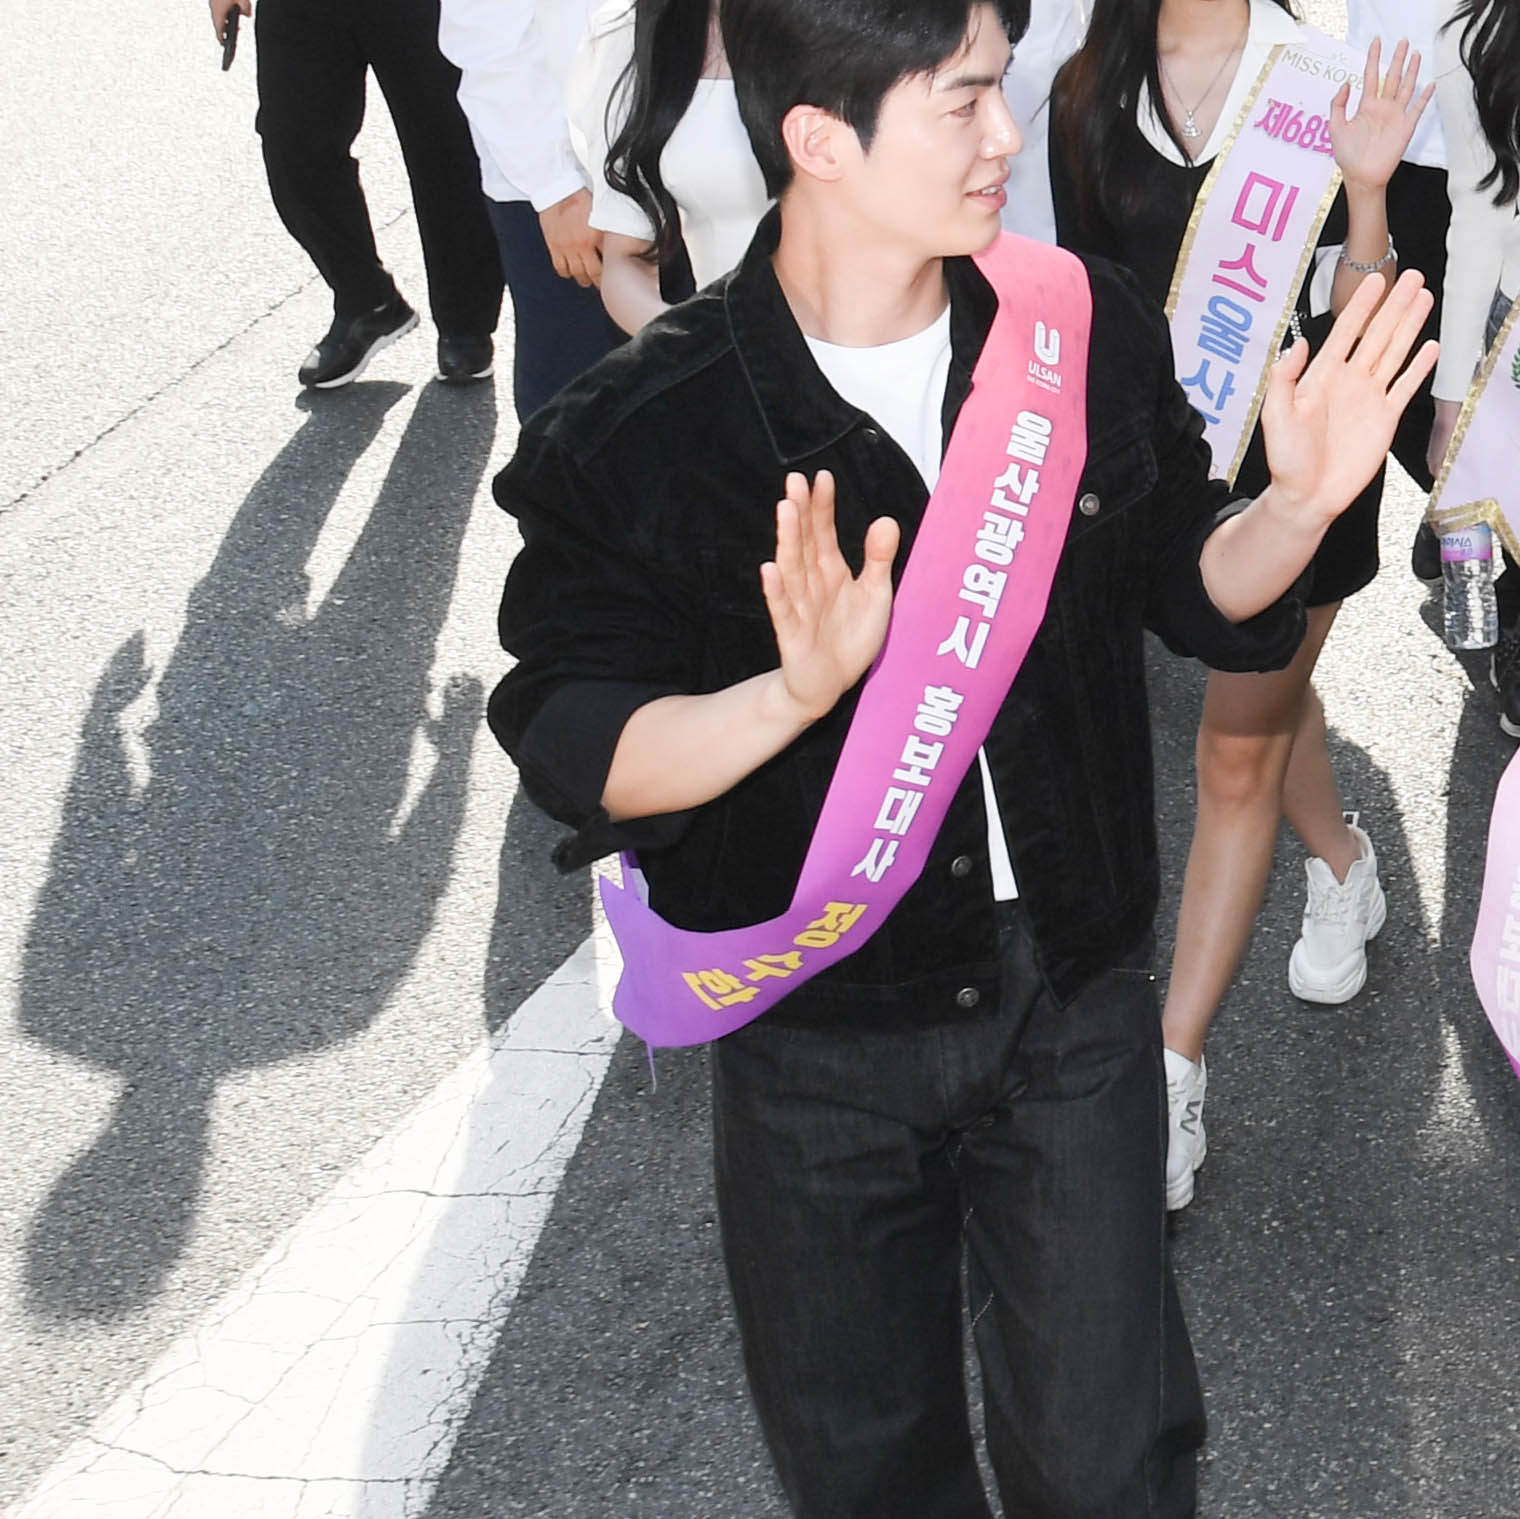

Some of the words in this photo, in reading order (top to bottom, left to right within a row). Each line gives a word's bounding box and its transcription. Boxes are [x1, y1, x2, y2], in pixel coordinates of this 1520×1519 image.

[1280, 47, 1324, 77] MISS
[1323, 59, 1367, 91] KORE
[1027, 359, 1062, 387] ULSAN
[936, 408, 1053, 671] 울산광역시
[851, 683, 965, 884] 홍보대사
[683, 899, 867, 1012] 정수한
